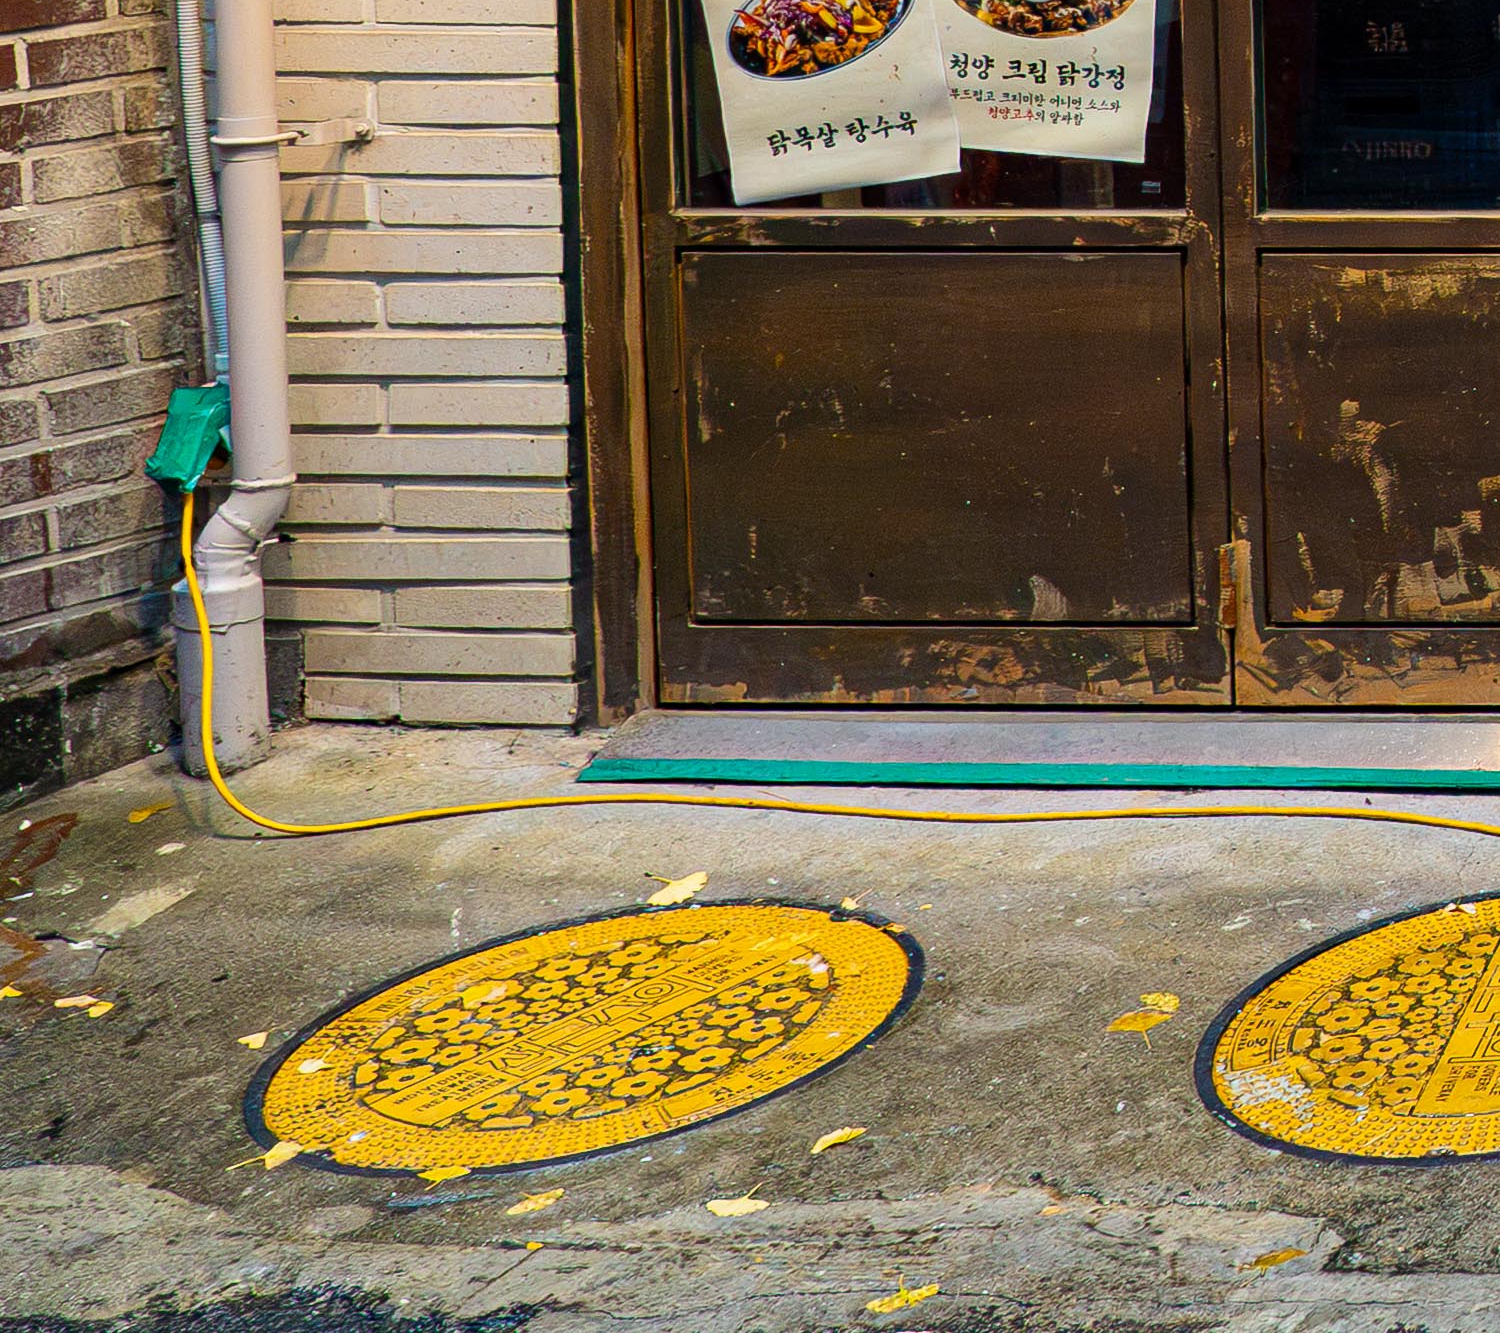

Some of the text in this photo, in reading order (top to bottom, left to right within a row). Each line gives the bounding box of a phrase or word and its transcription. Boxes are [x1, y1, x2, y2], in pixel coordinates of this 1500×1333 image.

[950, 53, 1125, 90] 청양 크림 닭강정
[765, 112, 918, 156] 닭목살 탕수육
